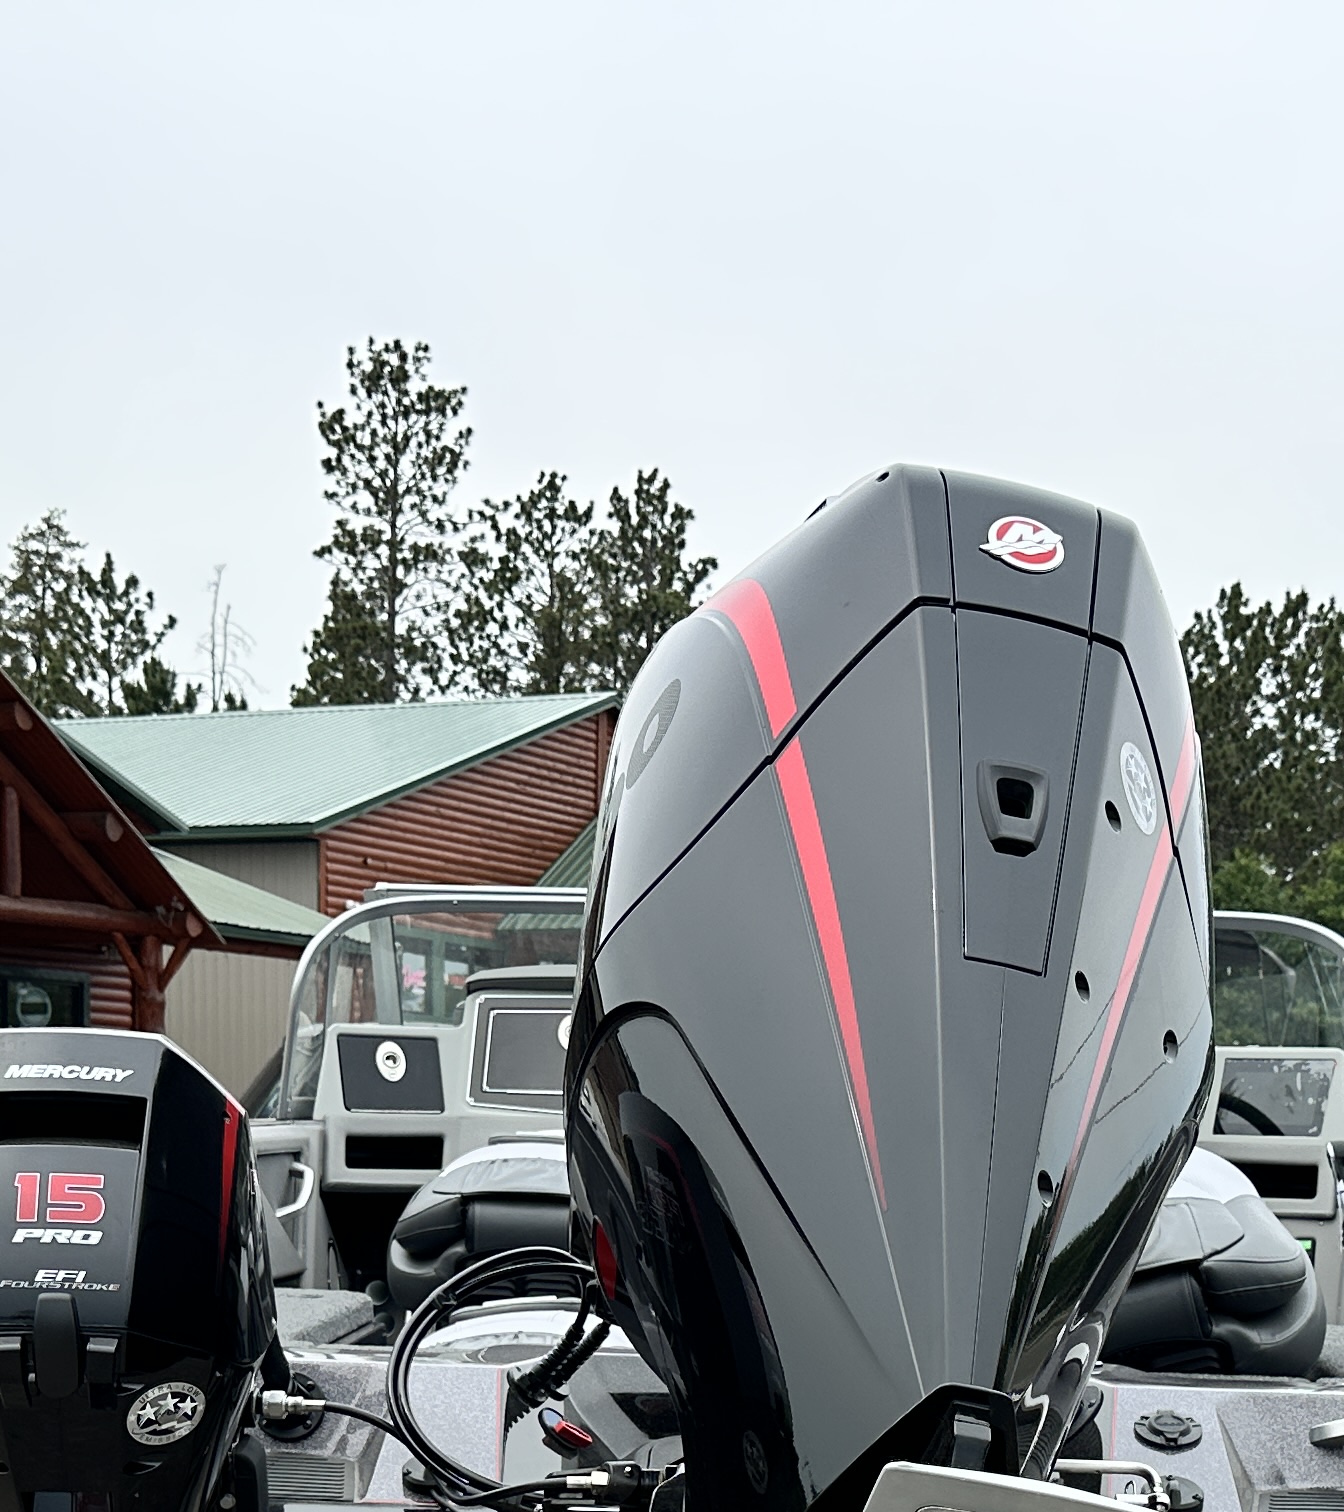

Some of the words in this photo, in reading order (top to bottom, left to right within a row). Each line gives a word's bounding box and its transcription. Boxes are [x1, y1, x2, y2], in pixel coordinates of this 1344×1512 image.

[4, 1064, 134, 1083] MERCURY
[14, 1172, 106, 1224] 15
[11, 1228, 104, 1245] PRO
[0, 1279, 121, 1292] FOURSTROKE
[34, 1269, 87, 1284] EFI
[138, 1383, 173, 1404] ULTRA
[181, 1384, 202, 1398] LOW
